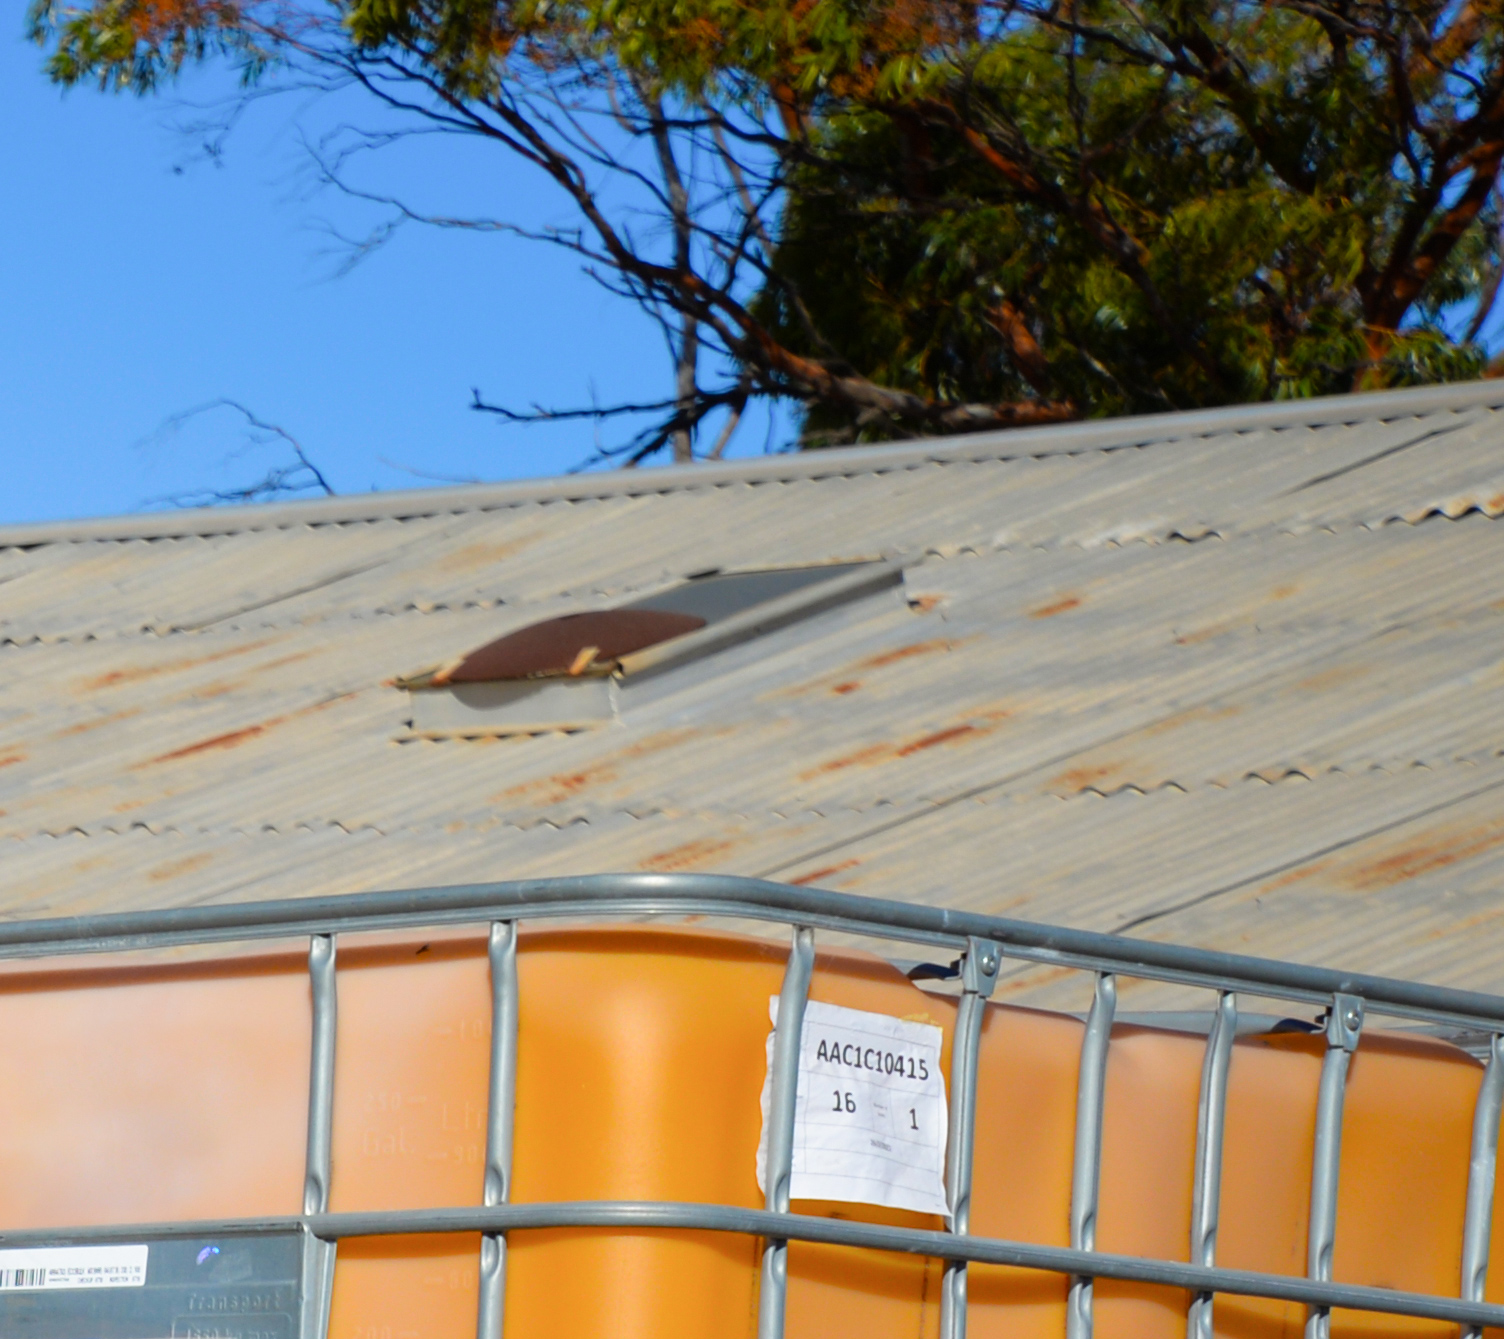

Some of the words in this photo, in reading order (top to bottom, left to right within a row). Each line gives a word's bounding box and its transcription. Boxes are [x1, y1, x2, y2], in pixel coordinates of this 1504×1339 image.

[817, 1039, 929, 1081] AAC1C10415
[832, 1090, 856, 1113] 16
[909, 1109, 919, 1129] 1
